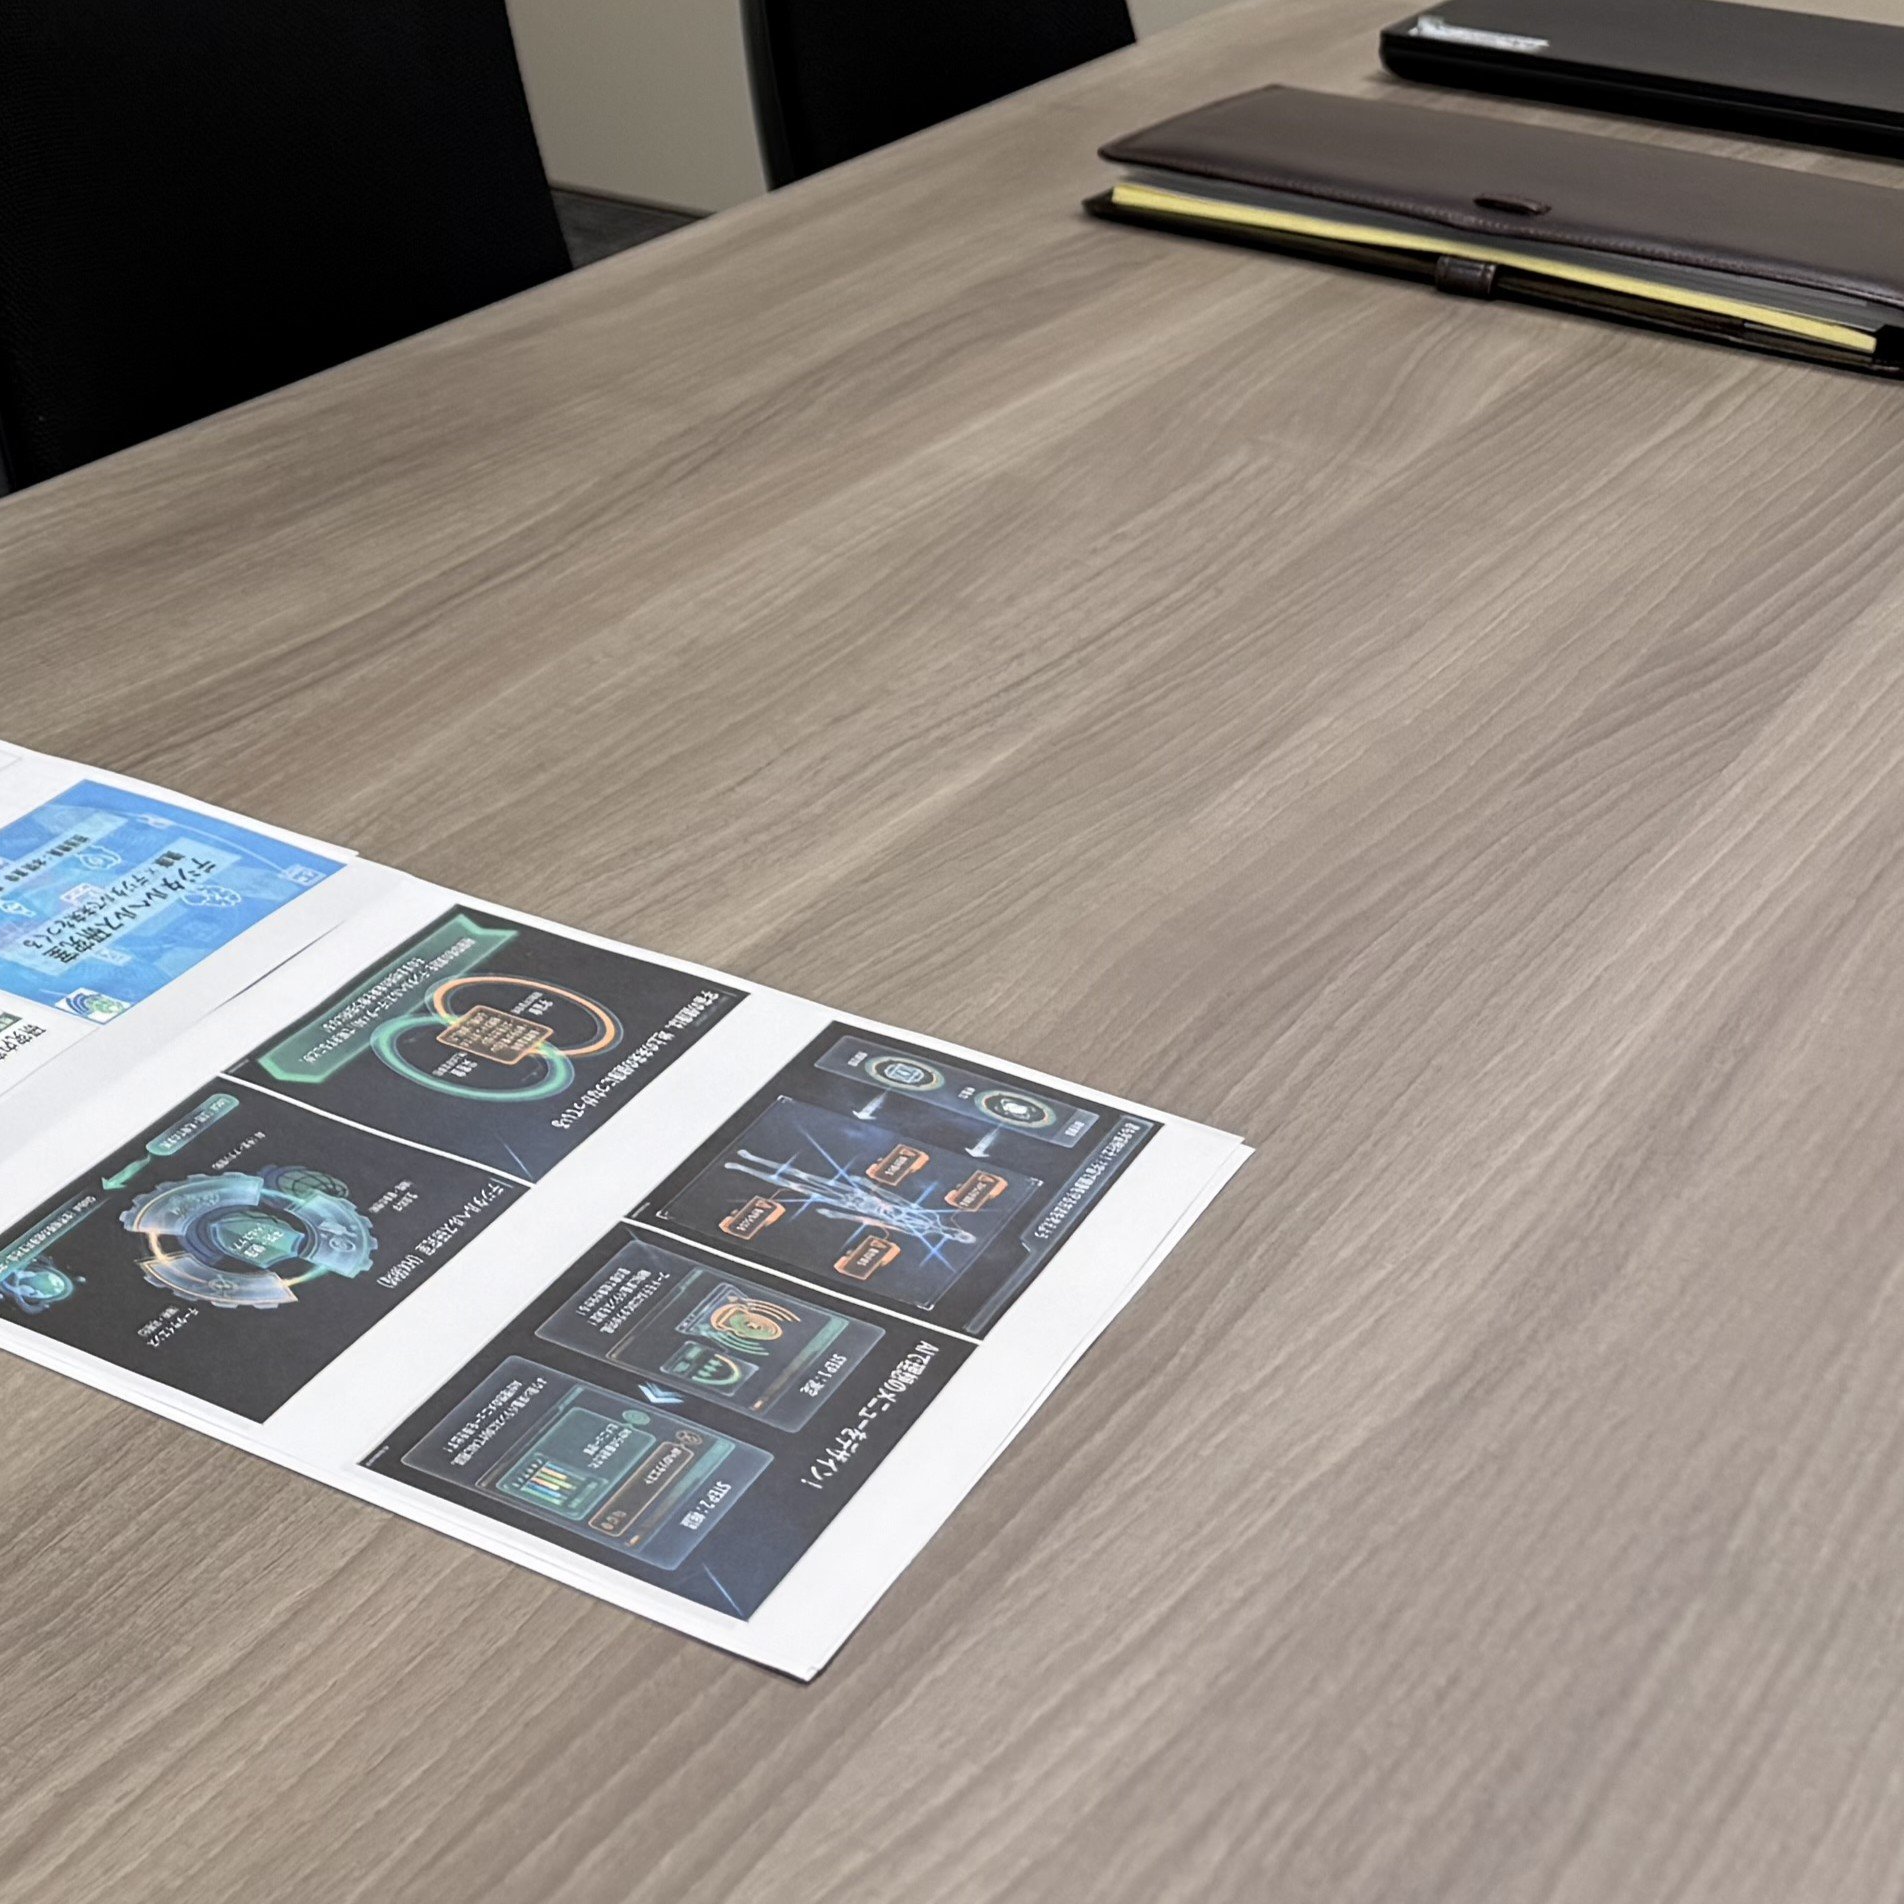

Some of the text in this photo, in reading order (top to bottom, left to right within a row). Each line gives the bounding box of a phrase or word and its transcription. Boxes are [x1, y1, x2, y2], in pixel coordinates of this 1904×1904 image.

[37, 856, 222, 964] デジタルヘルス研究室
[797, 1339, 944, 1490] AIで理想のメニューをデザイン！
